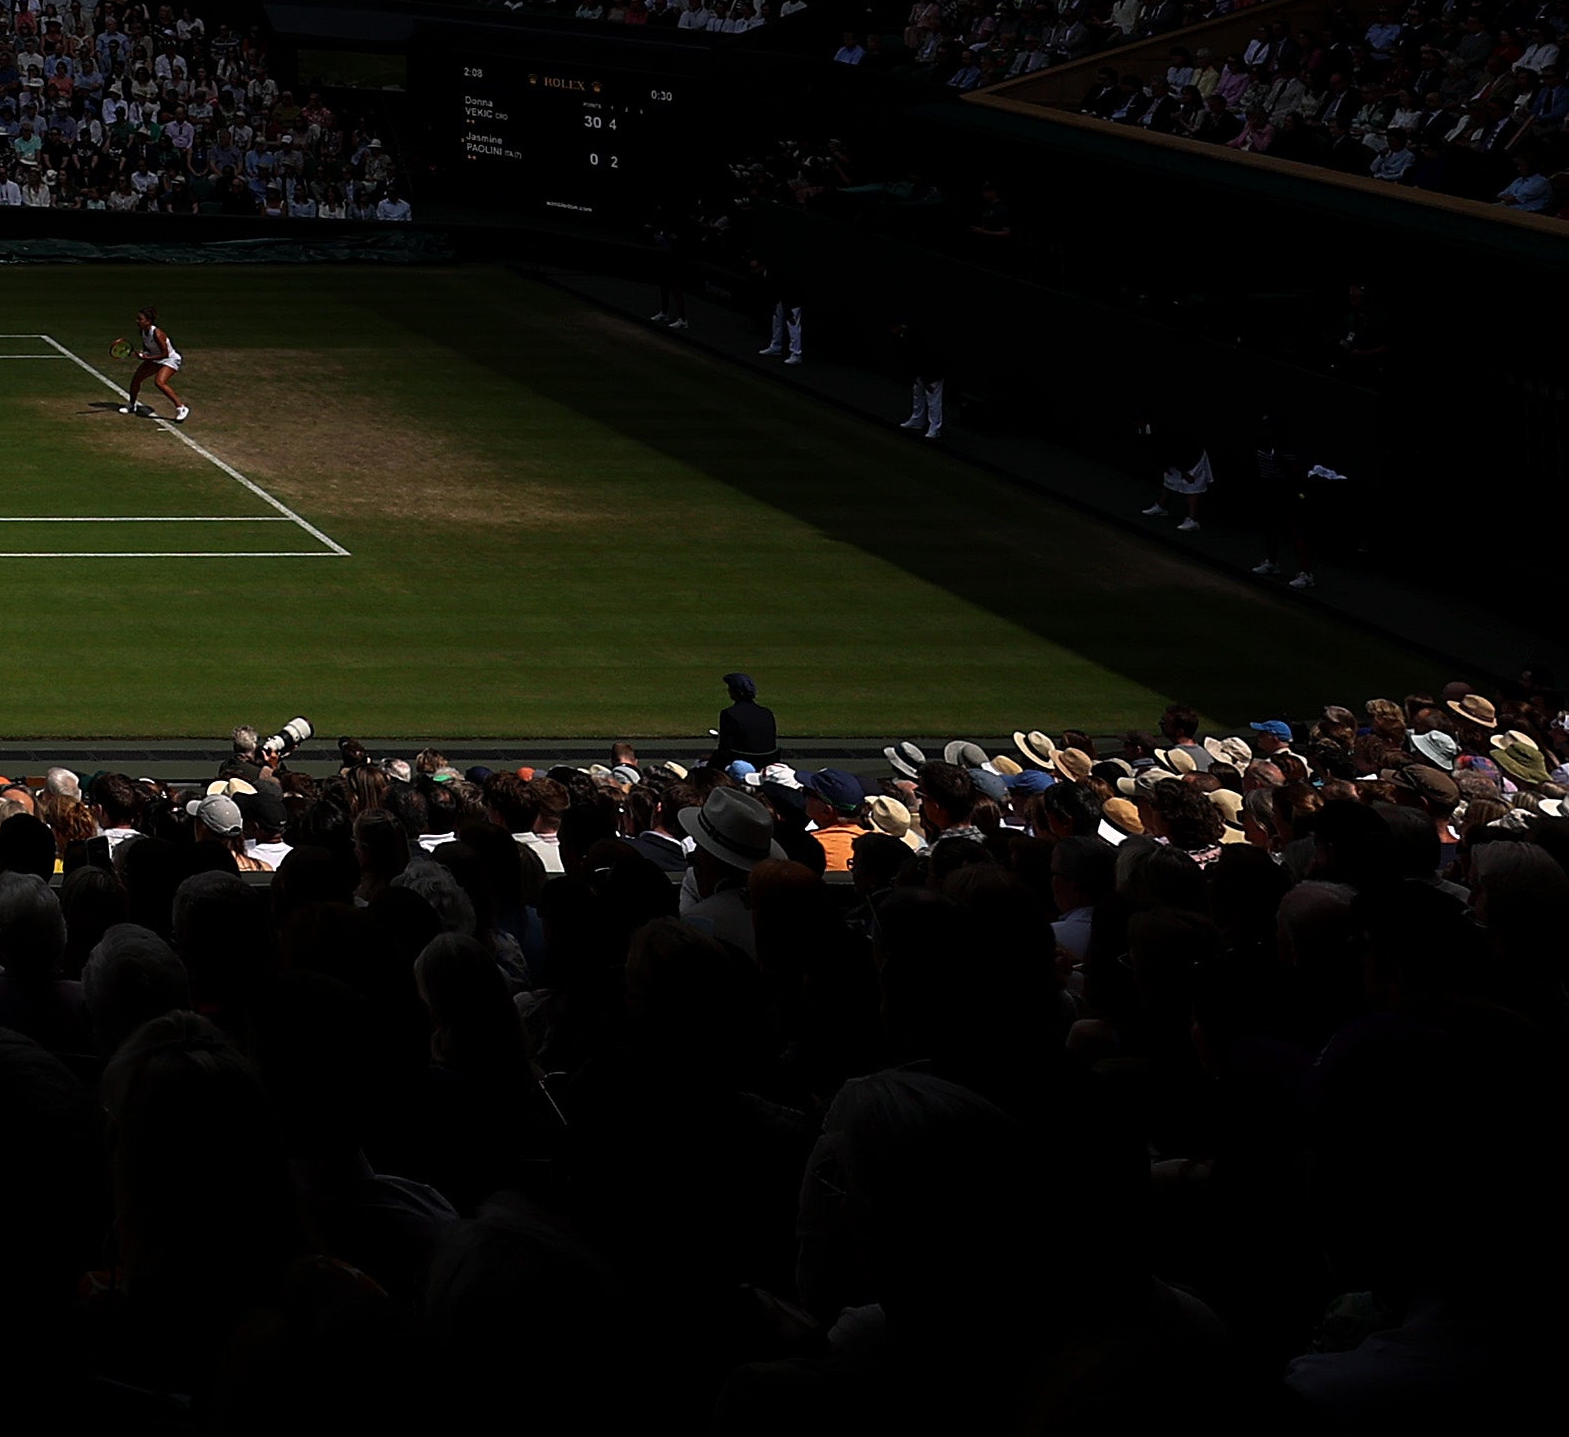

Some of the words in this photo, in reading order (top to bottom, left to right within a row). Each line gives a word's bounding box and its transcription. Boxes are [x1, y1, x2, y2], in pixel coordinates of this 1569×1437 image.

[464, 67, 483, 78] 2:08
[544, 77, 586, 91] ROLEX
[465, 95, 493, 107] Donna
[651, 90, 672, 101] 0:30
[465, 107, 493, 118] VEKIC
[584, 115, 602, 128] 30
[609, 119, 617, 130] 4
[466, 132, 503, 144] Jasmine
[466, 143, 502, 155] PAOLINI
[590, 153, 598, 165] 0
[611, 156, 618, 168] 2
